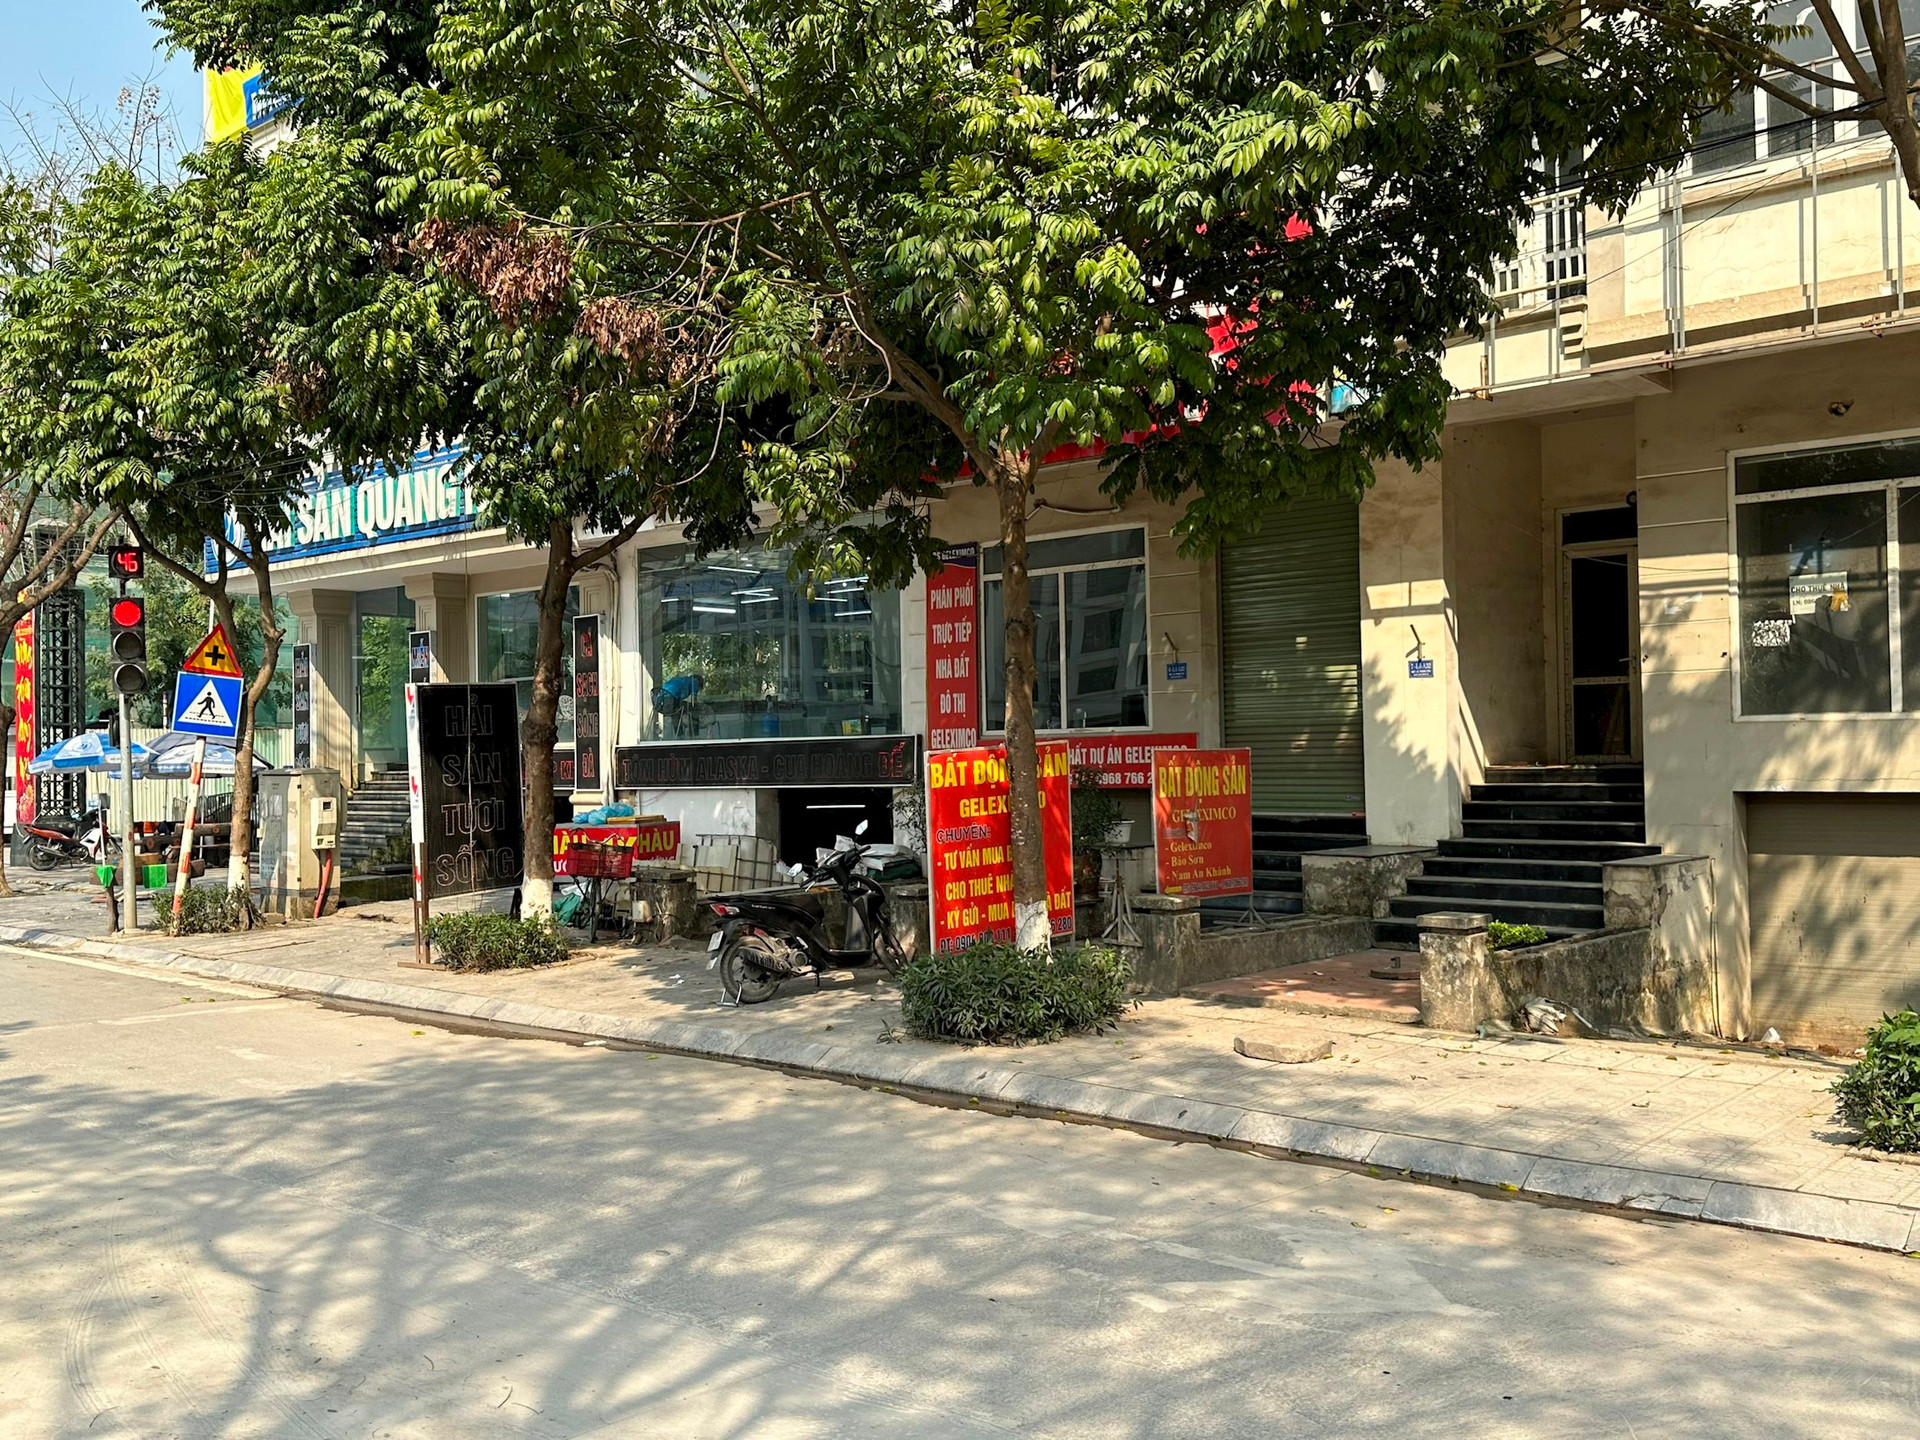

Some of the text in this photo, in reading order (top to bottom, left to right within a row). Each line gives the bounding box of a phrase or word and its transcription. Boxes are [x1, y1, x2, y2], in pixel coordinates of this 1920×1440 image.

[357, 463, 458, 538] QUANG
[117, 552, 138, 572] 46
[931, 579, 974, 610] PHÂN PHỐI
[1791, 586, 1806, 594] CHO
[1808, 584, 1827, 592] THUÊ
[932, 615, 972, 648] TRỰC TIẾP
[935, 651, 970, 679] NHÀ ĐẤT
[445, 694, 493, 737] HẢI
[940, 690, 966, 717] ĐÔ THỊ
[931, 727, 977, 750] GELEXIMCO
[442, 743, 501, 787] SẢN
[696, 755, 759, 781] ALASKA
[930, 745, 1067, 789] BẤT ĐỘN ẢN
[1090, 745, 1105, 768] DỰ
[1107, 743, 1122, 764] ÁN
[1124, 771, 1144, 785] 766
[1158, 755, 1246, 804] BẤT ĐỘNG SẢN
[441, 797, 506, 836] TƯƠI
[639, 828, 675, 853] HÀU
[936, 821, 991, 843] CHUYÊN:
[436, 841, 515, 887] SỐNG
[944, 850, 958, 871] TƯ
[959, 843, 980, 868] VẤN
[982, 846, 1004, 866] MUA
[945, 880, 966, 900] CHO
[969, 873, 994, 897] THUÊ
[1171, 866, 1232, 881] Nam An Khánh
[947, 905, 960, 929] KÝ
[963, 901, 979, 927] GỬI
[988, 903, 1010, 923] MUA
[1054, 886, 1072, 910] ĐẤT
[1057, 916, 1072, 931] 280
